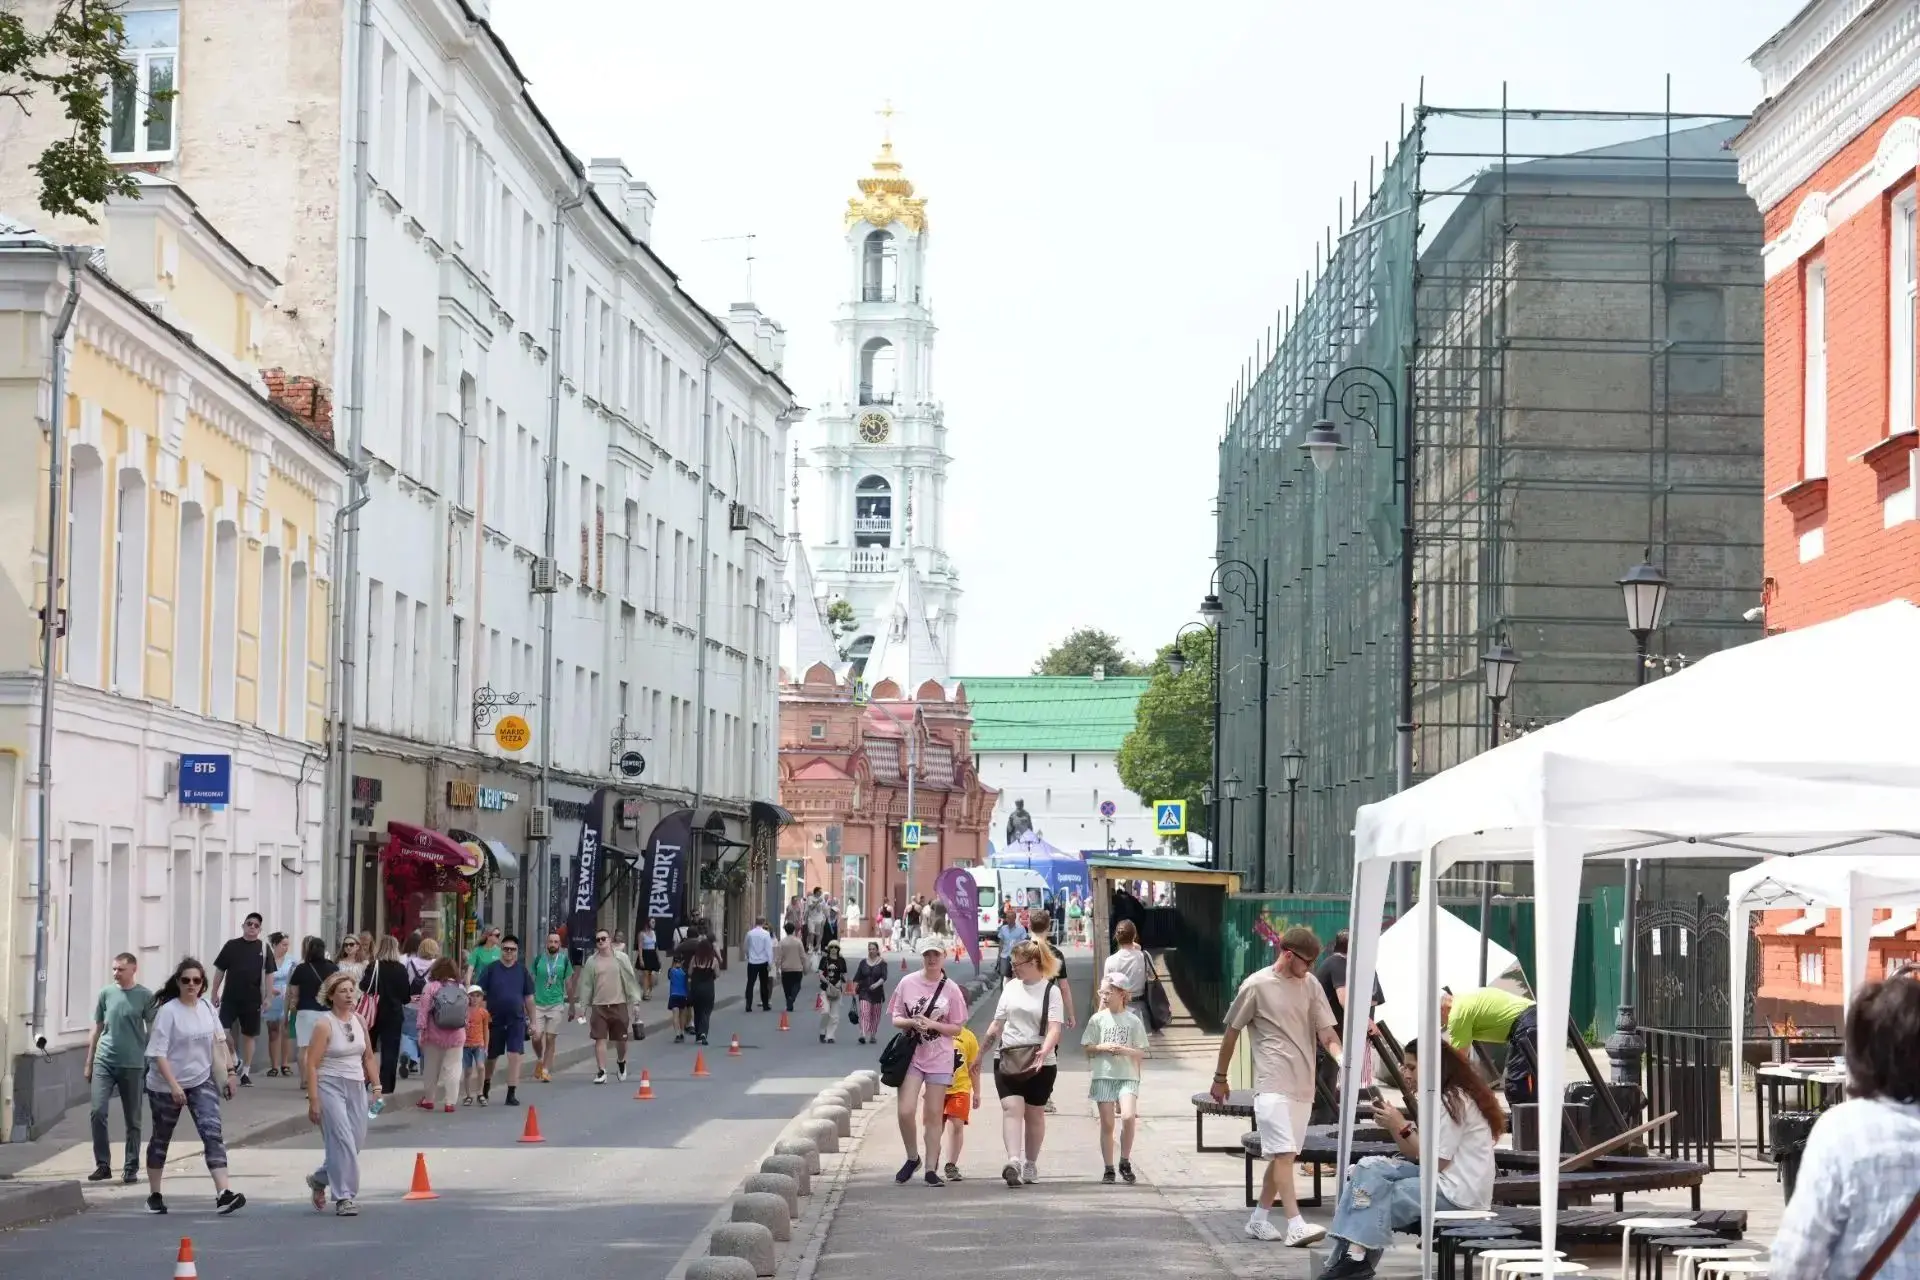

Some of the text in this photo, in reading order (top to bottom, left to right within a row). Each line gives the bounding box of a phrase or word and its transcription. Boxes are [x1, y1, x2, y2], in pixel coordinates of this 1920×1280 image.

[194, 762, 216, 773] ВТБ
[575, 823, 597, 913] REWORT
[648, 839, 681, 918] REWORT
